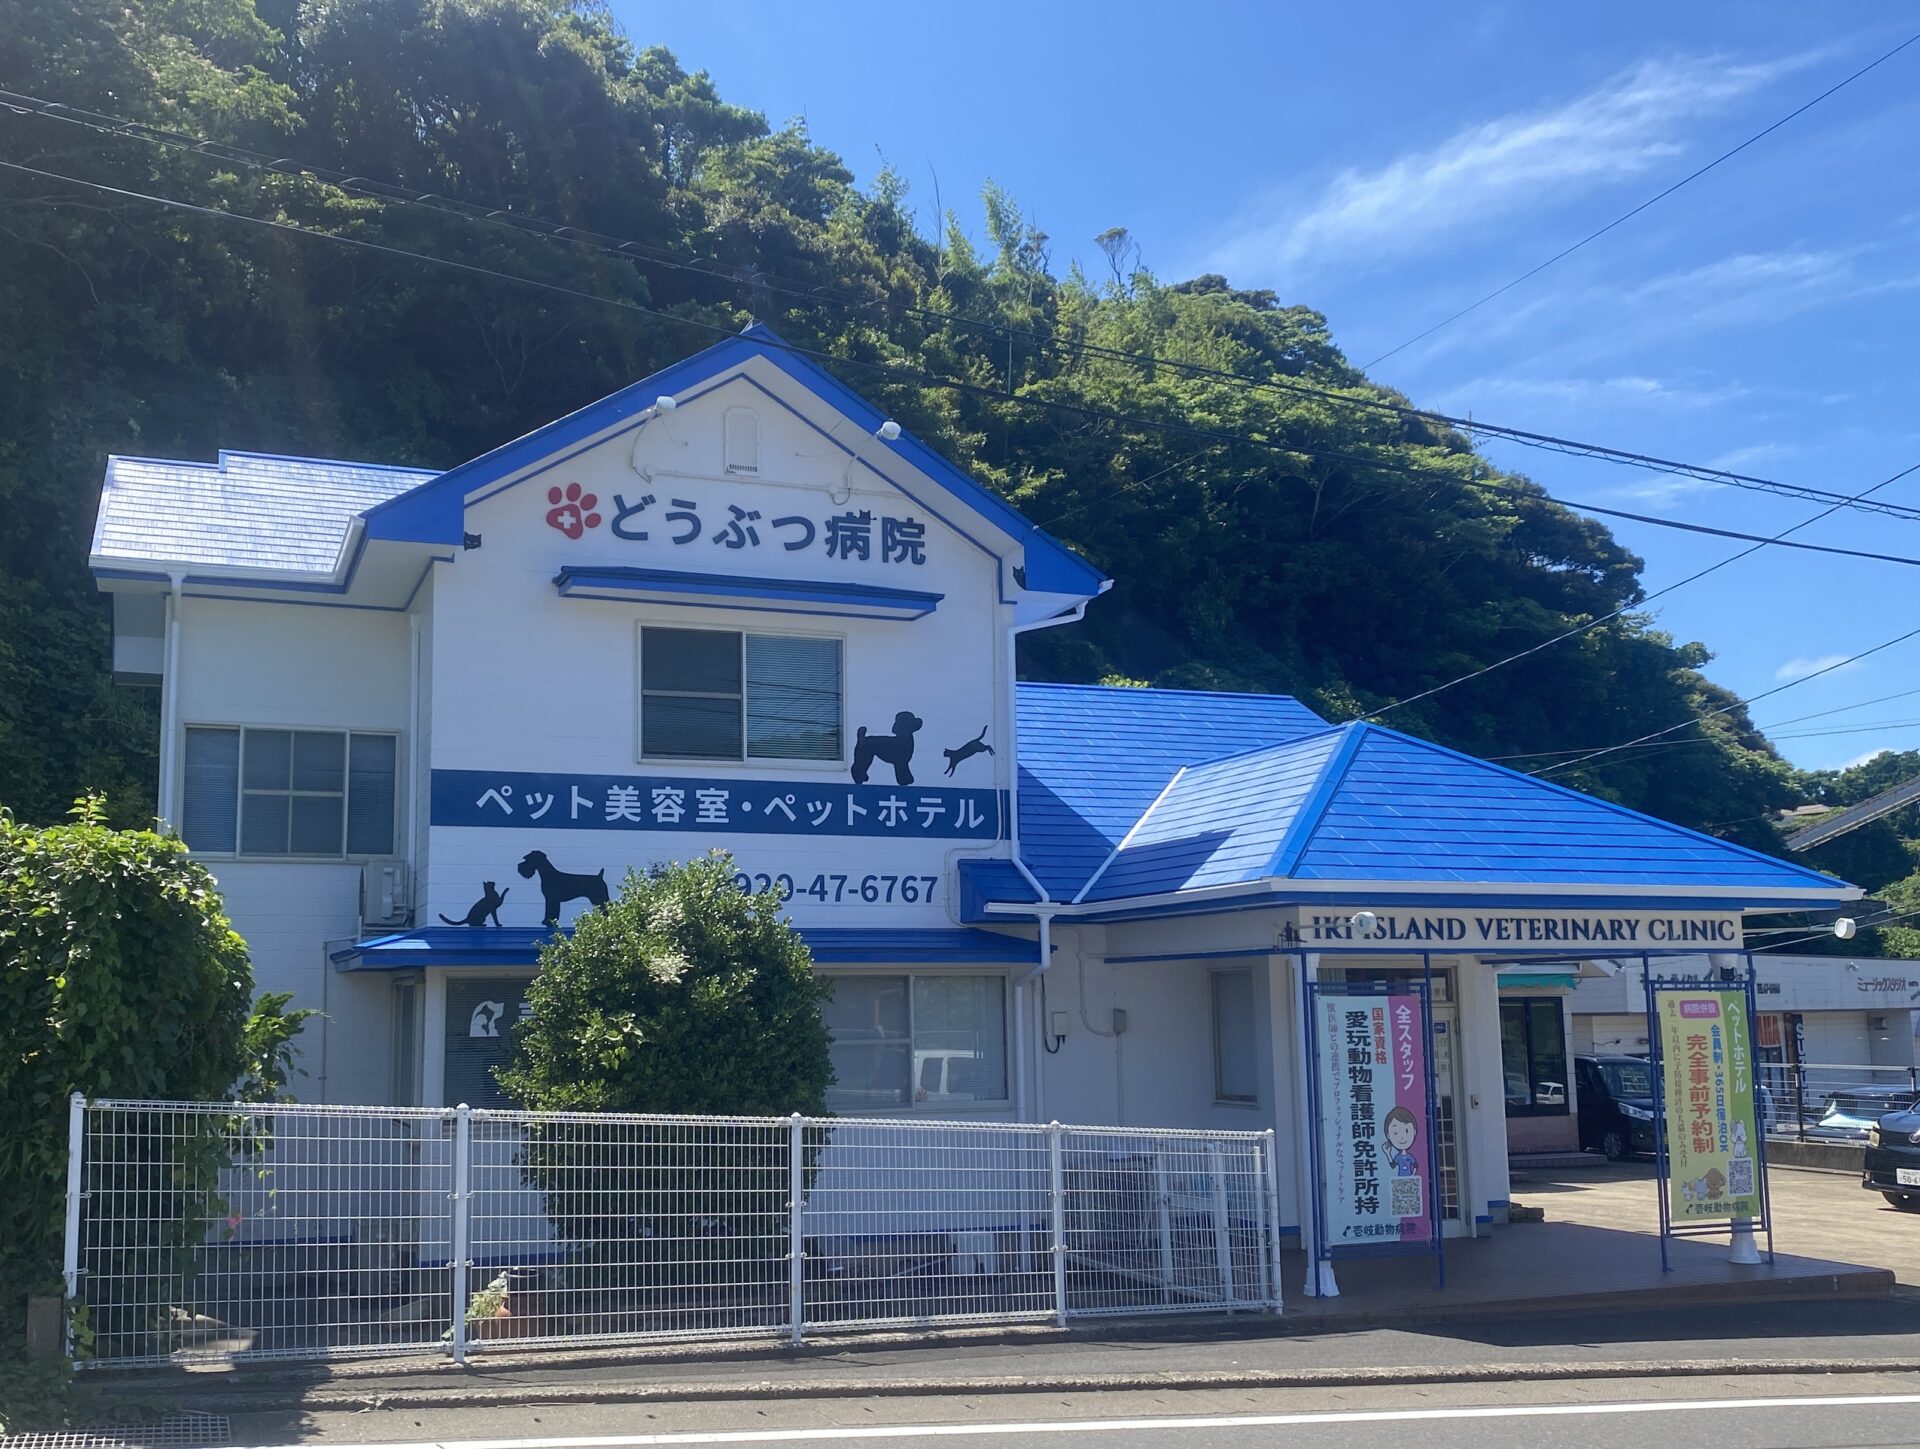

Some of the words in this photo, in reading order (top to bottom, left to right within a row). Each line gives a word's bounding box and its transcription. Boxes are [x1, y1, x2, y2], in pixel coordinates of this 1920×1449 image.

[611, 494, 927, 565] どうぶつ病院
[475, 785, 985, 830] ペット美容室・ペットホテル
[1312, 915, 1353, 940] IKI
[1363, 916, 1466, 941] SLAND
[1474, 917, 1640, 941] VETERINARY
[1648, 919, 1736, 942] CLINIC
[1372, 1007, 1387, 1065] 国家資格
[1396, 1004, 1415, 1090] 全スタッフ
[1727, 1000, 1747, 1094] ペットホテル
[1345, 1010, 1380, 1216] 愛玩動物看護師免許所持
[1686, 1034, 1715, 1153] 完全事前予約制
[1353, 1222, 1417, 1238] 壱岐動物病院
